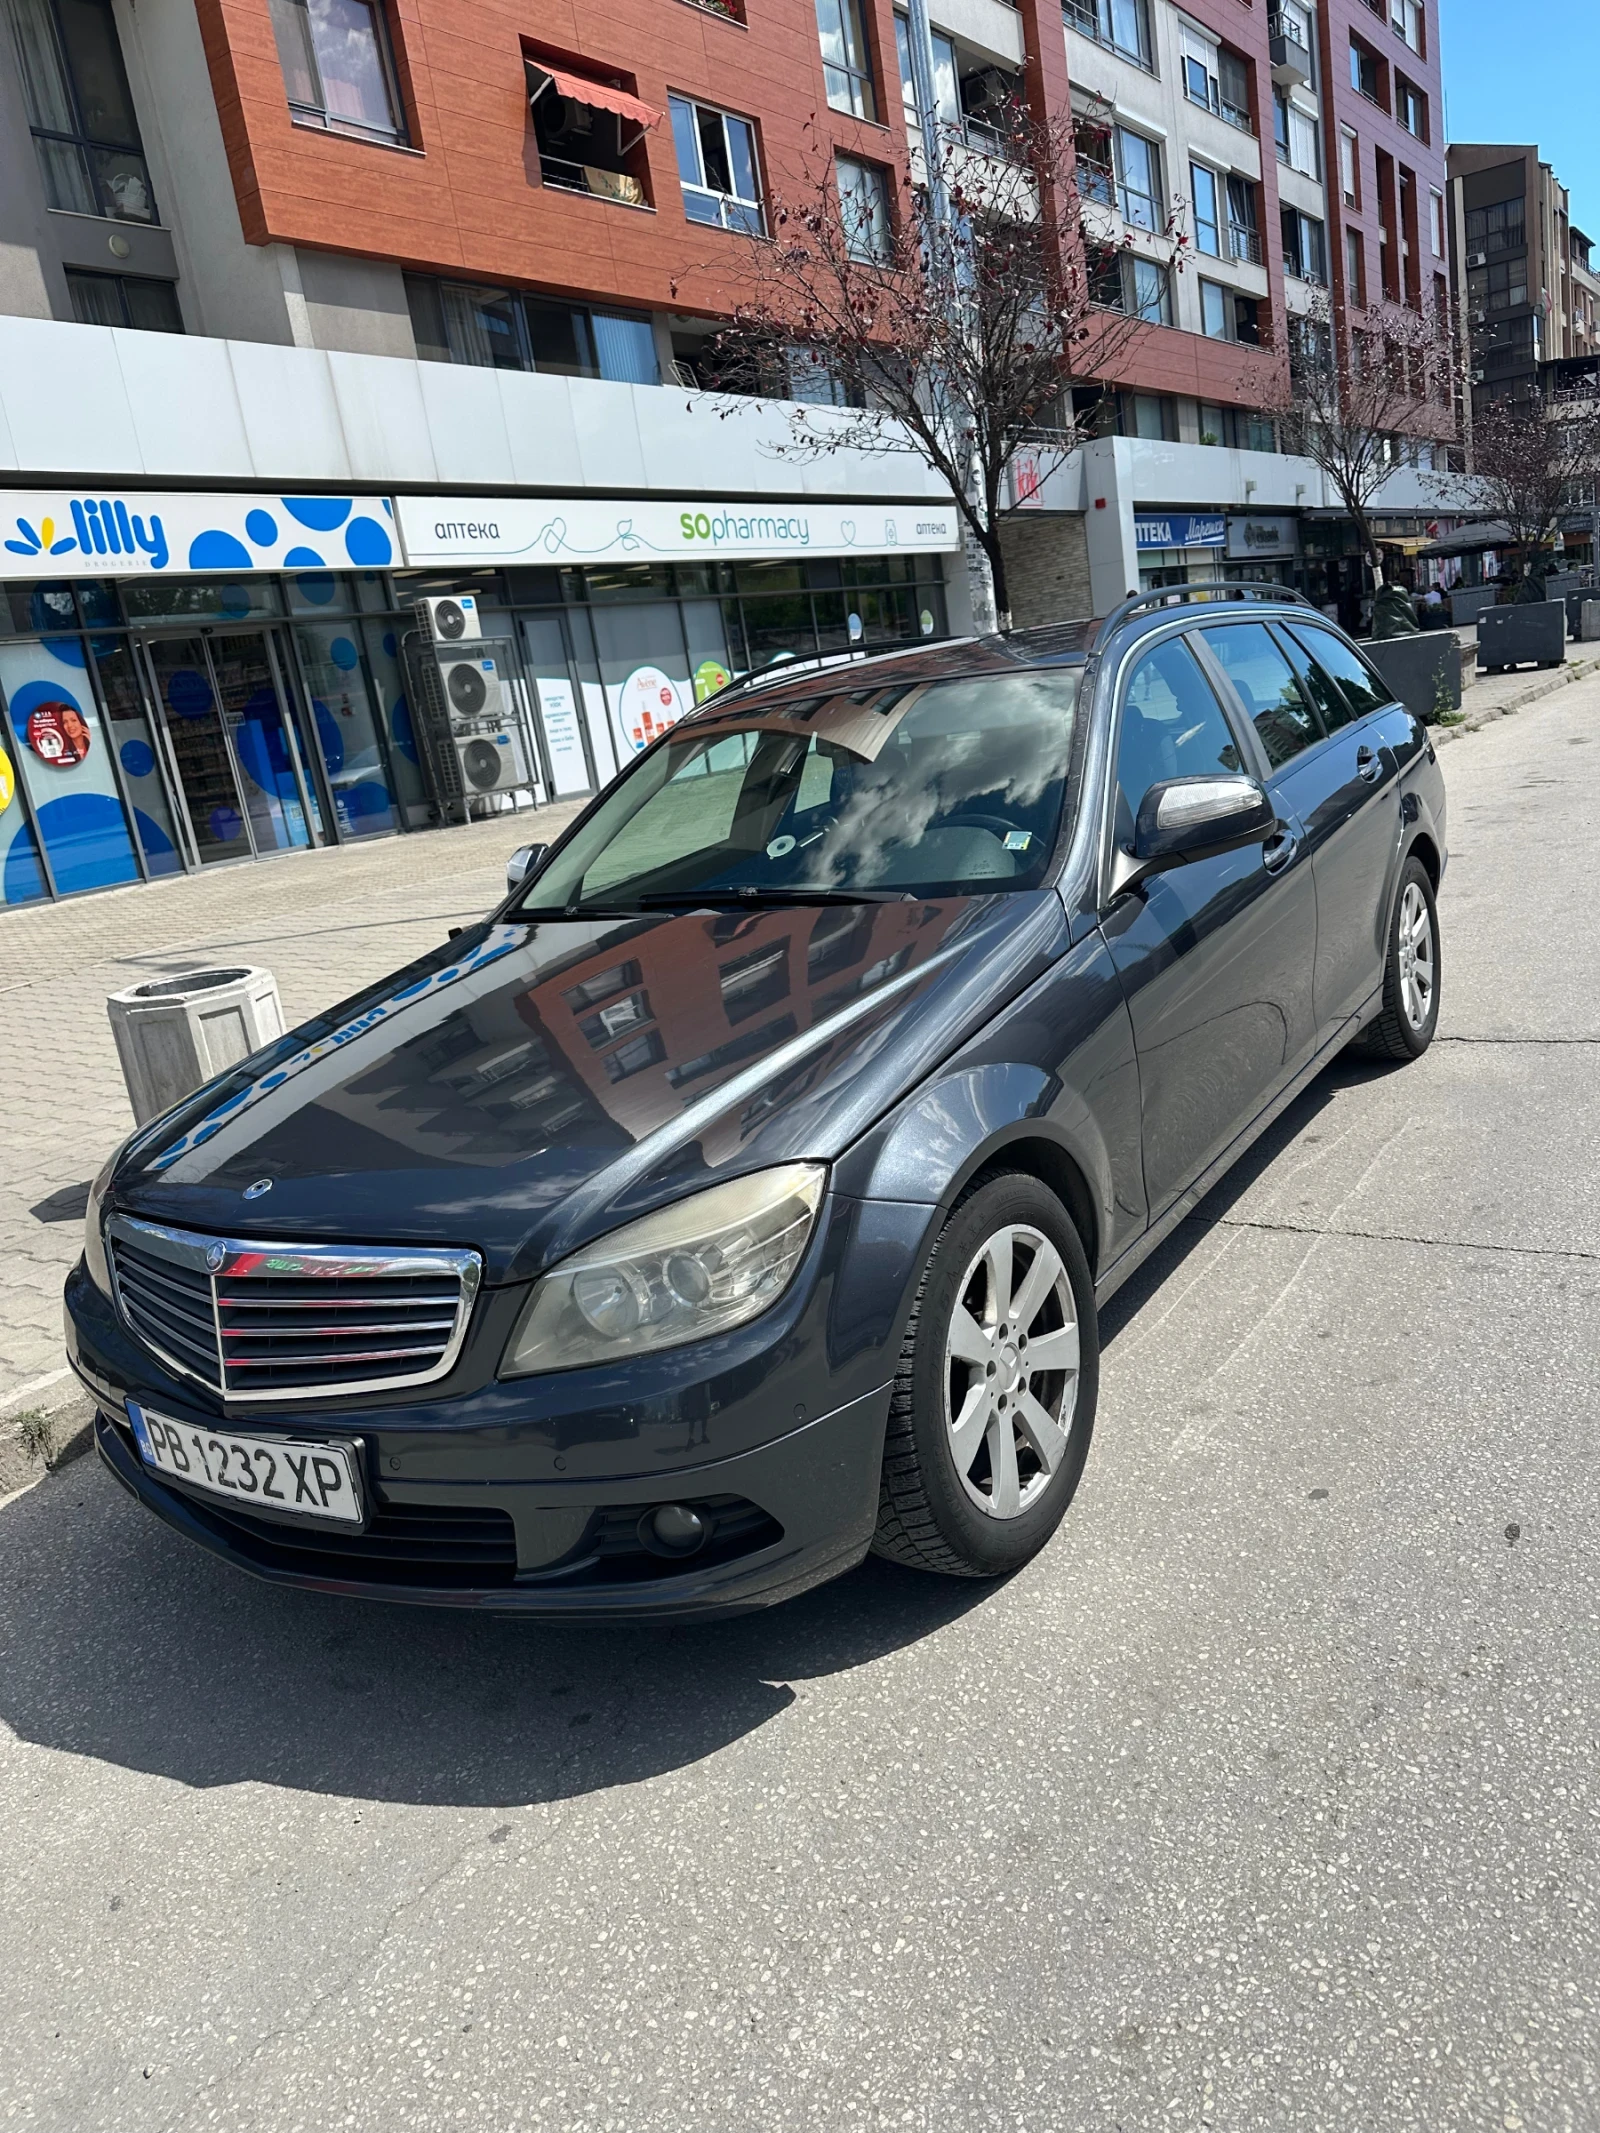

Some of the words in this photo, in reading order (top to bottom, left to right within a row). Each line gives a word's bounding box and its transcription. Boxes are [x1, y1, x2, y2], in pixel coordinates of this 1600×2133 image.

[70, 499, 169, 569] lilly
[434, 522, 501, 539] аптека
[915, 522, 947, 535] аптека
[140, 1440, 152, 1457] BG
